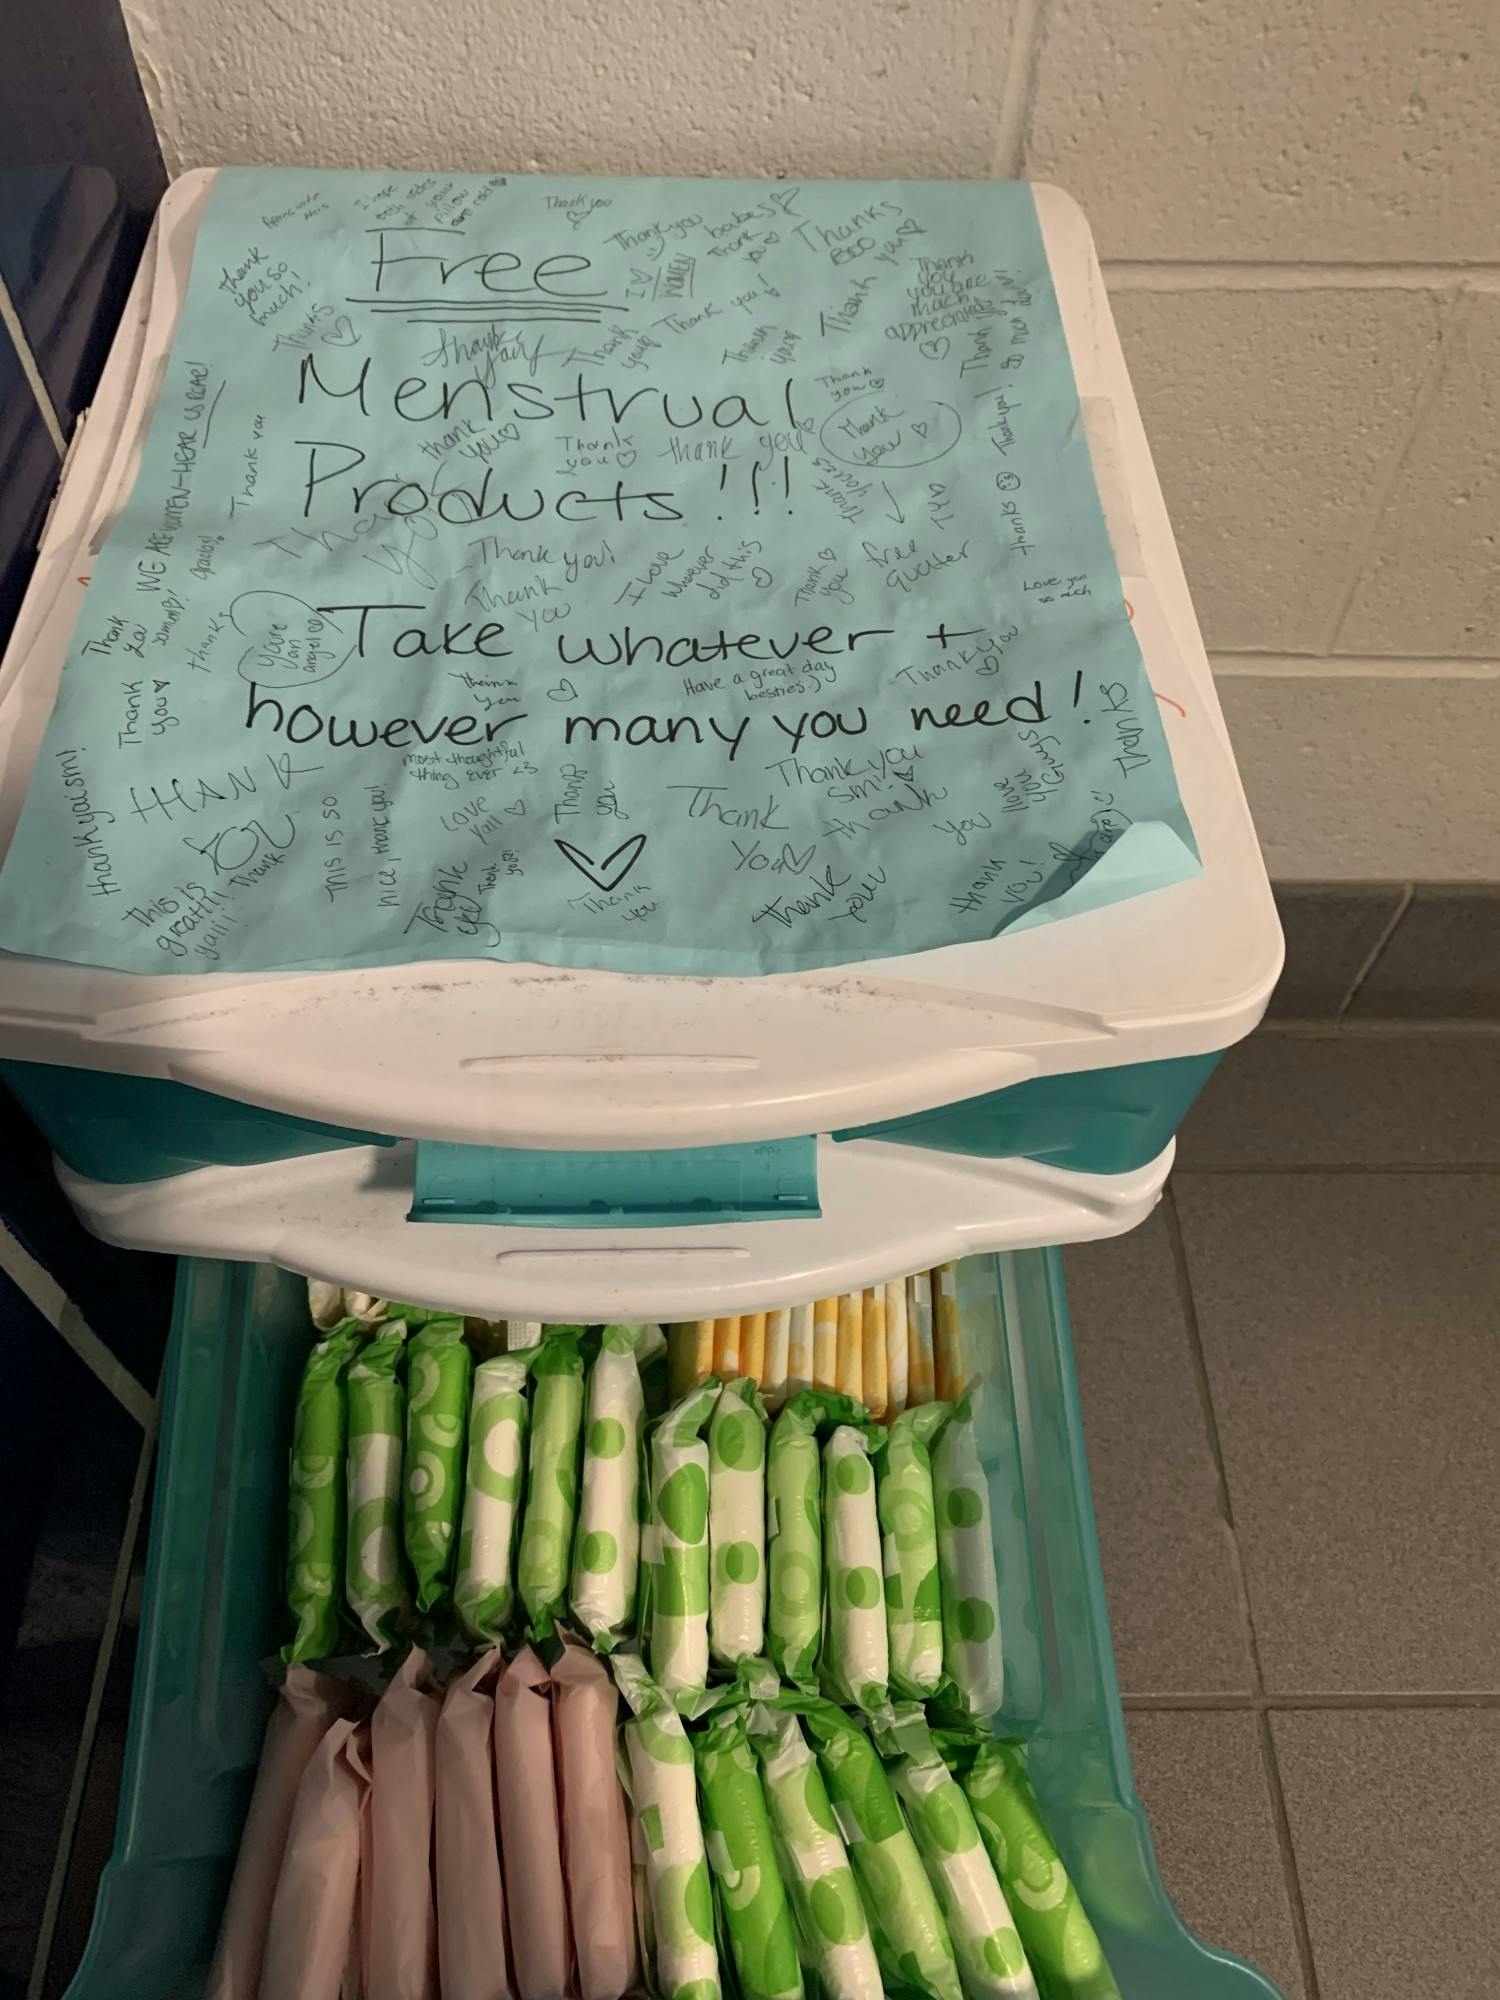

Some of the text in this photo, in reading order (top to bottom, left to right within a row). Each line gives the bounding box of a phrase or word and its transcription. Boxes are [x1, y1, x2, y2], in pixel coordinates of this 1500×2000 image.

[792, 200, 904, 253] Thanks
[364, 227, 608, 297] Free
[298, 352, 798, 430] Menstrual
[316, 604, 513, 659] Take
[557, 626, 896, 667] whatever
[683, 677, 722, 697] Have
[750, 662, 796, 690] great
[801, 659, 837, 684] day
[245, 670, 1091, 761] however many you need!
